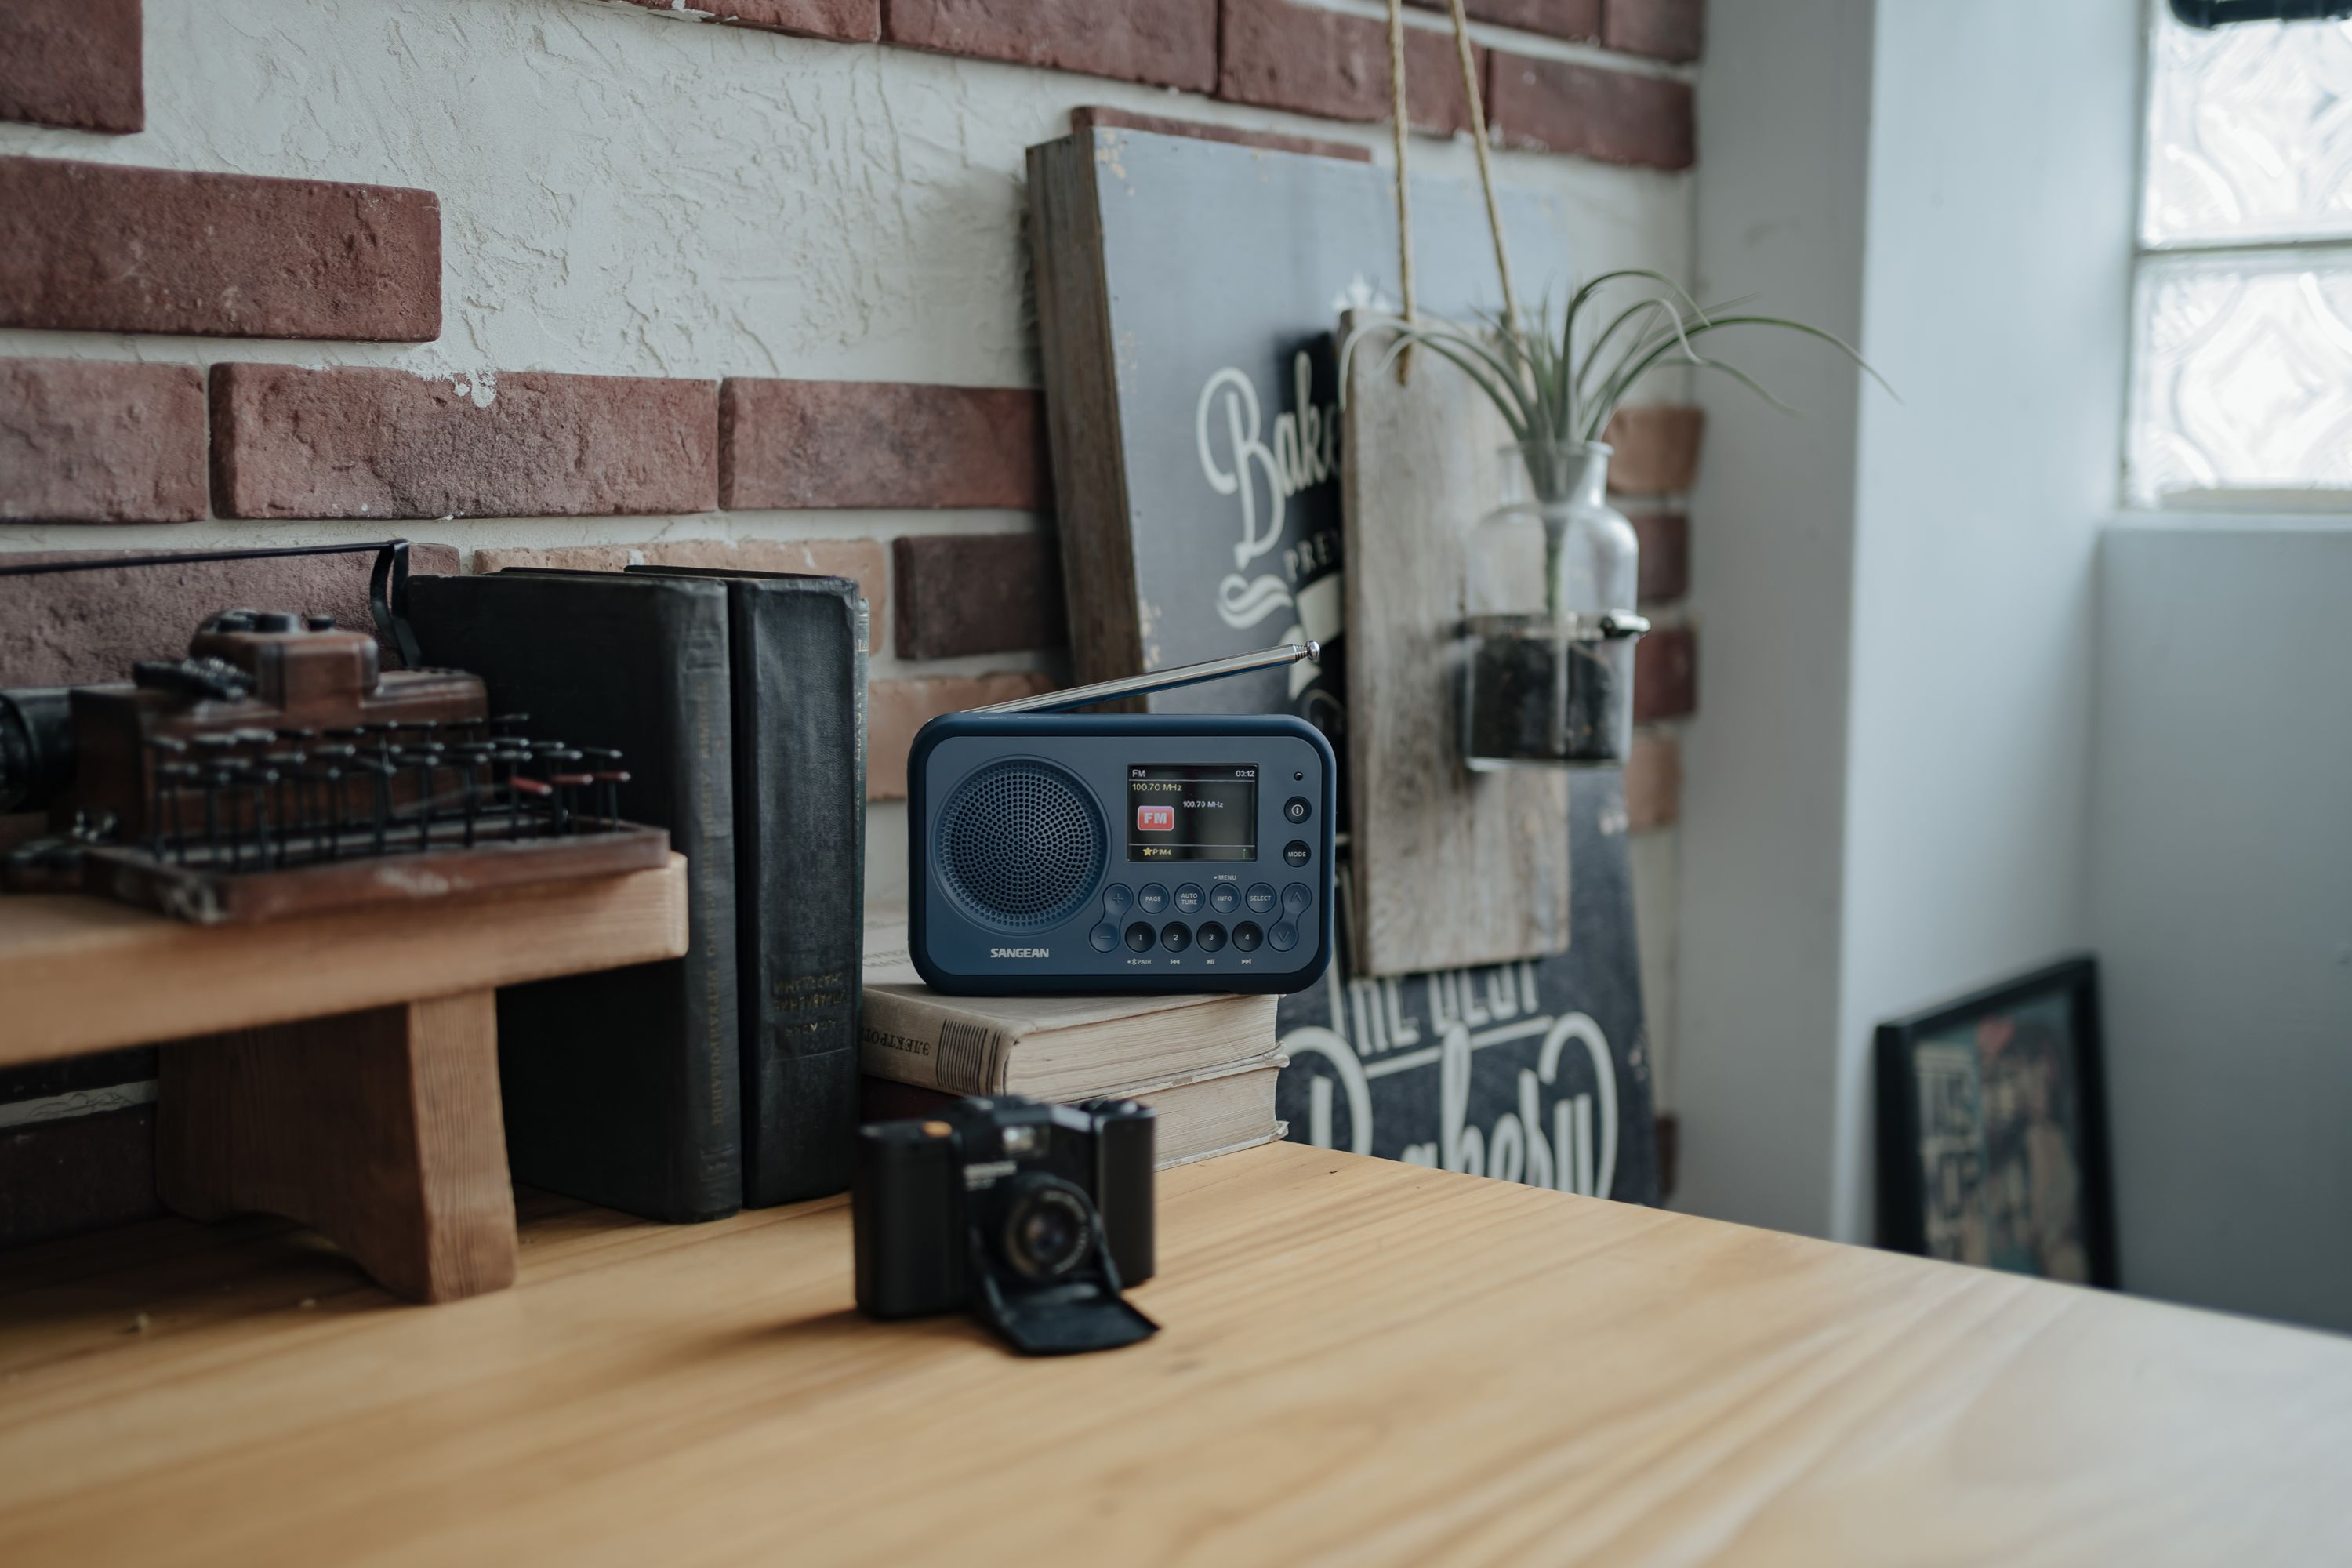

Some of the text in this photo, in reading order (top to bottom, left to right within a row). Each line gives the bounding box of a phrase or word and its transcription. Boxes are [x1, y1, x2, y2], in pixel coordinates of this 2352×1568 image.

[1131, 769, 1145, 778] FM
[1143, 811, 1167, 825] FM
[990, 948, 1050, 958] SANGEAN
